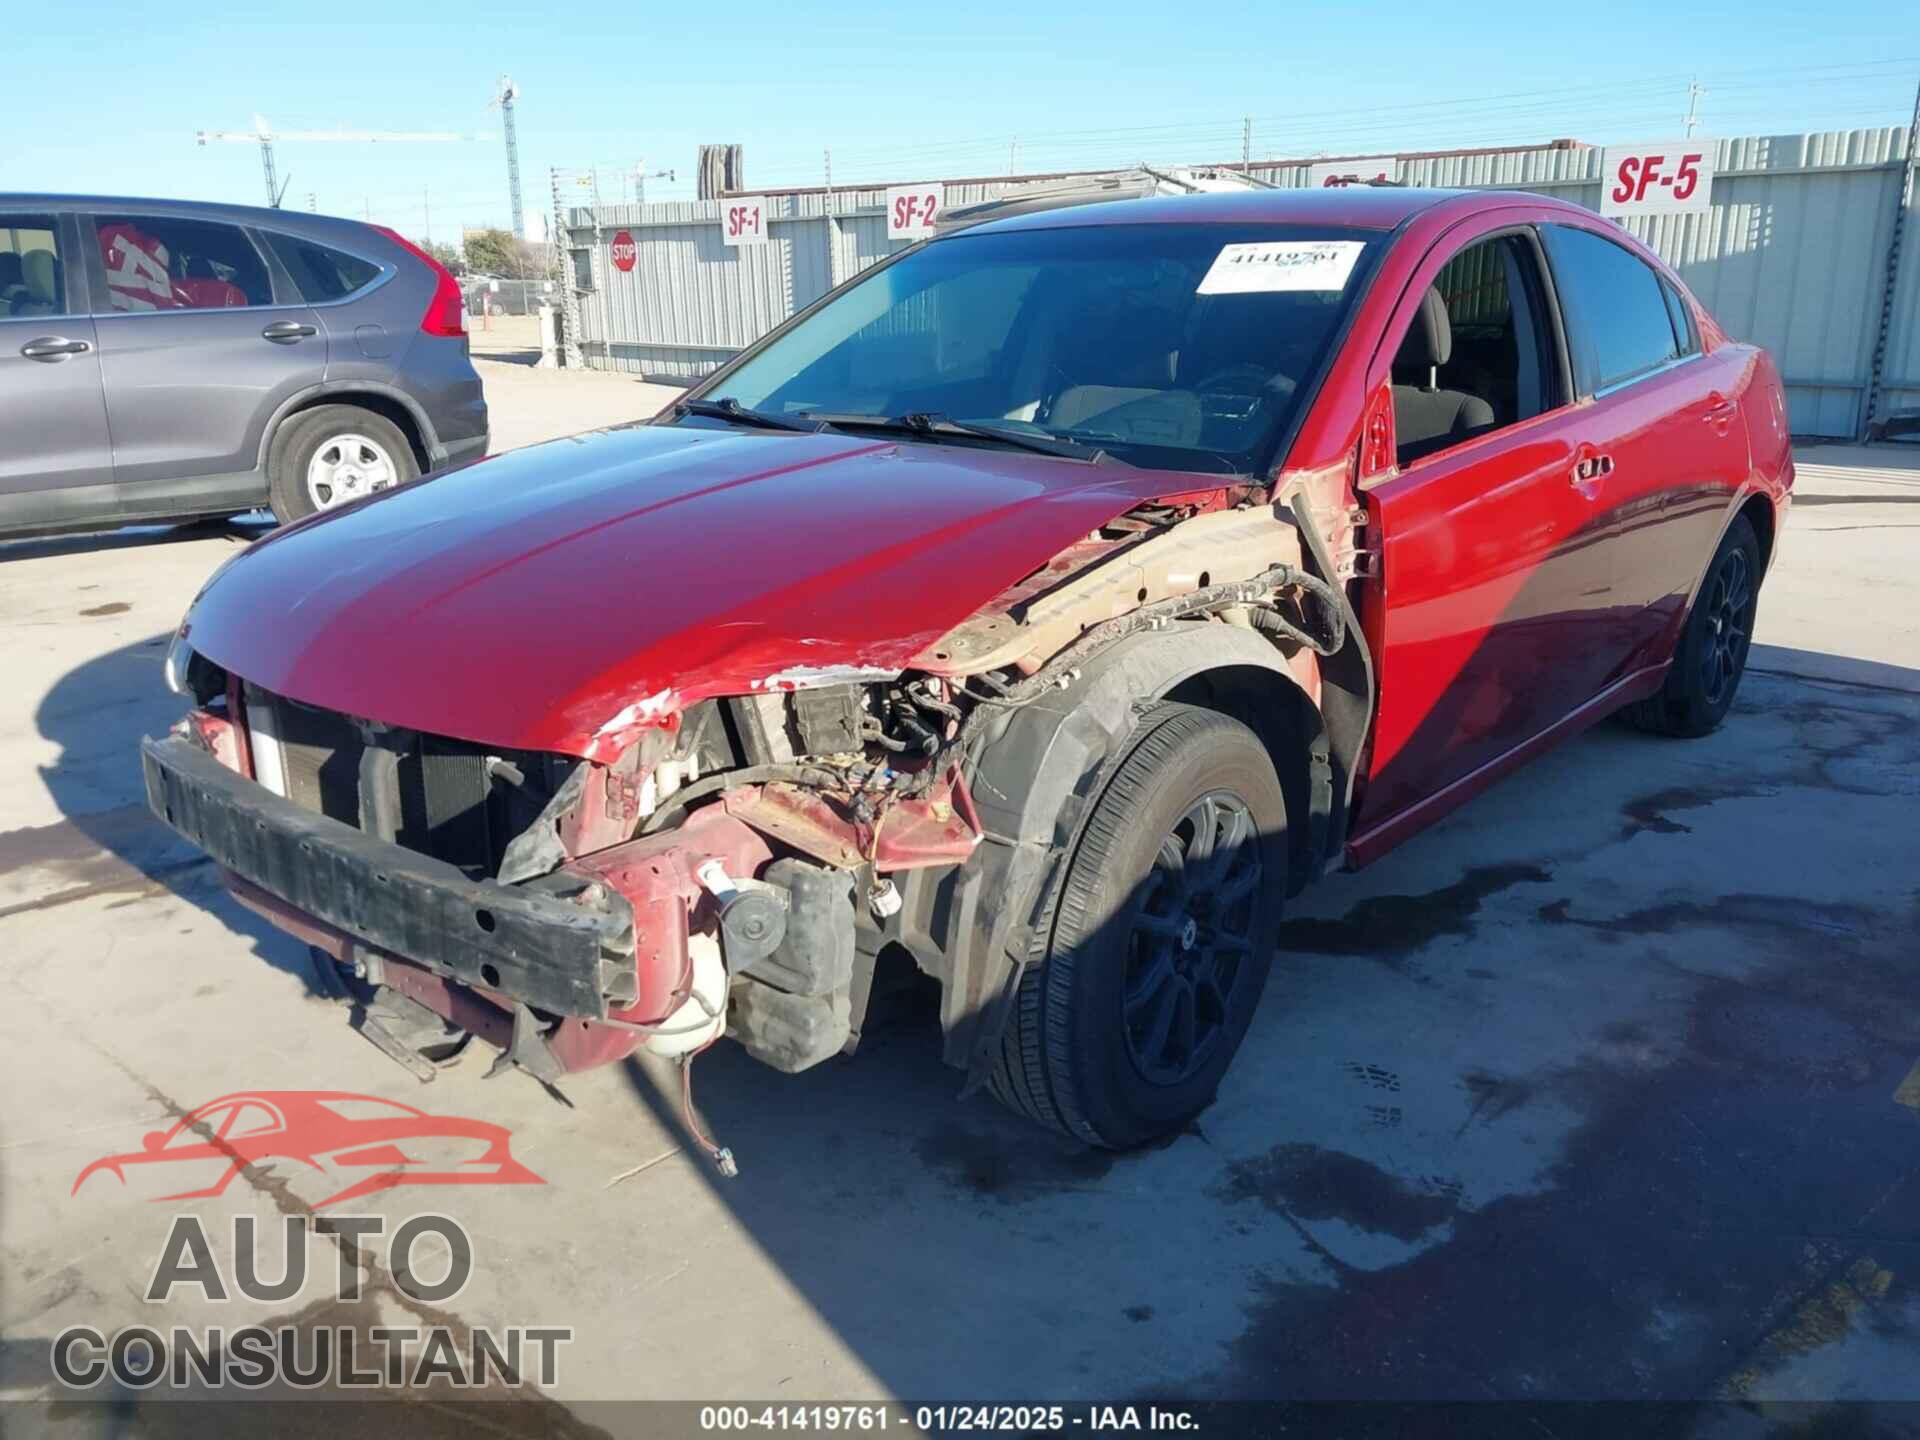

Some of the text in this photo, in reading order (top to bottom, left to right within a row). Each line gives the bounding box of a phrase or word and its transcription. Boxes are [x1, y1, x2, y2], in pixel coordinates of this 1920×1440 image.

[1612, 153, 1703, 203] SF-5
[728, 206, 760, 236] SF-1
[894, 194, 937, 229] SF-2
[612, 243, 636, 260] STOP
